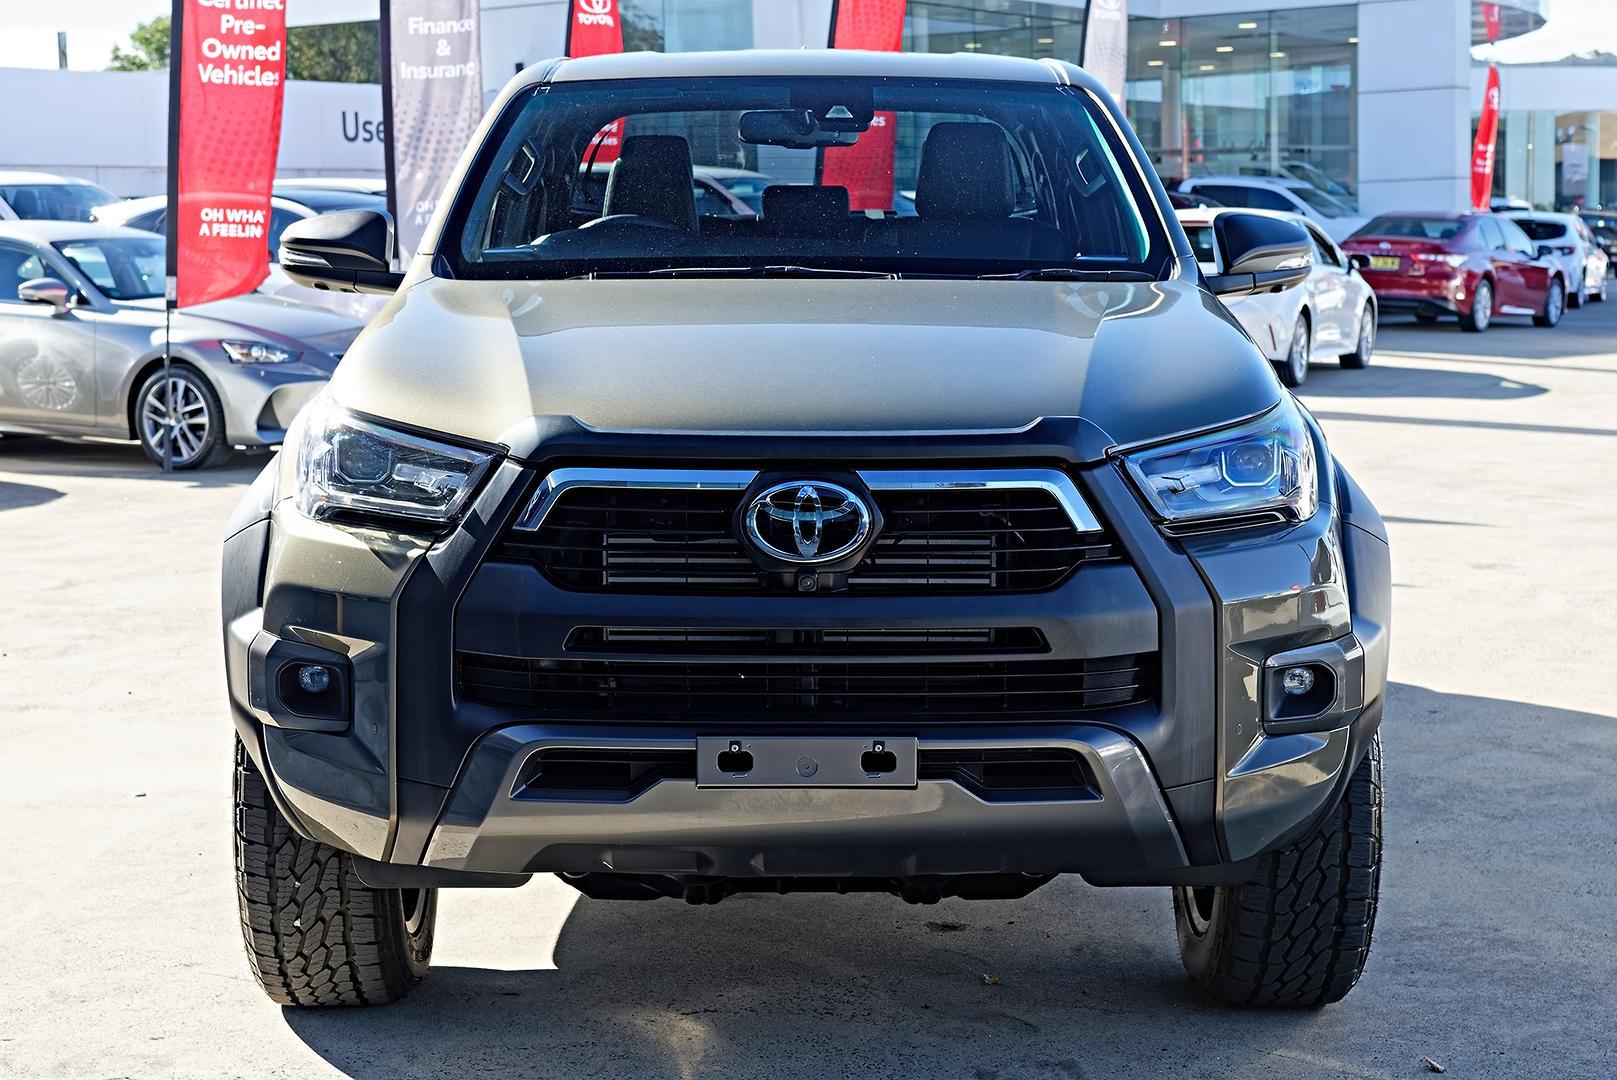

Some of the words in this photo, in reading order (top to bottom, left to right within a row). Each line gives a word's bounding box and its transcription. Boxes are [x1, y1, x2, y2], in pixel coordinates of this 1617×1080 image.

[221, 13, 266, 35] Pre-
[408, 16, 475, 34] Finance
[201, 37, 280, 61] Owned
[436, 39, 451, 56] &
[200, 208, 225, 221] OH
[226, 208, 266, 223] WHA
[199, 223, 210, 237] A
[212, 223, 264, 238] FEELIN
